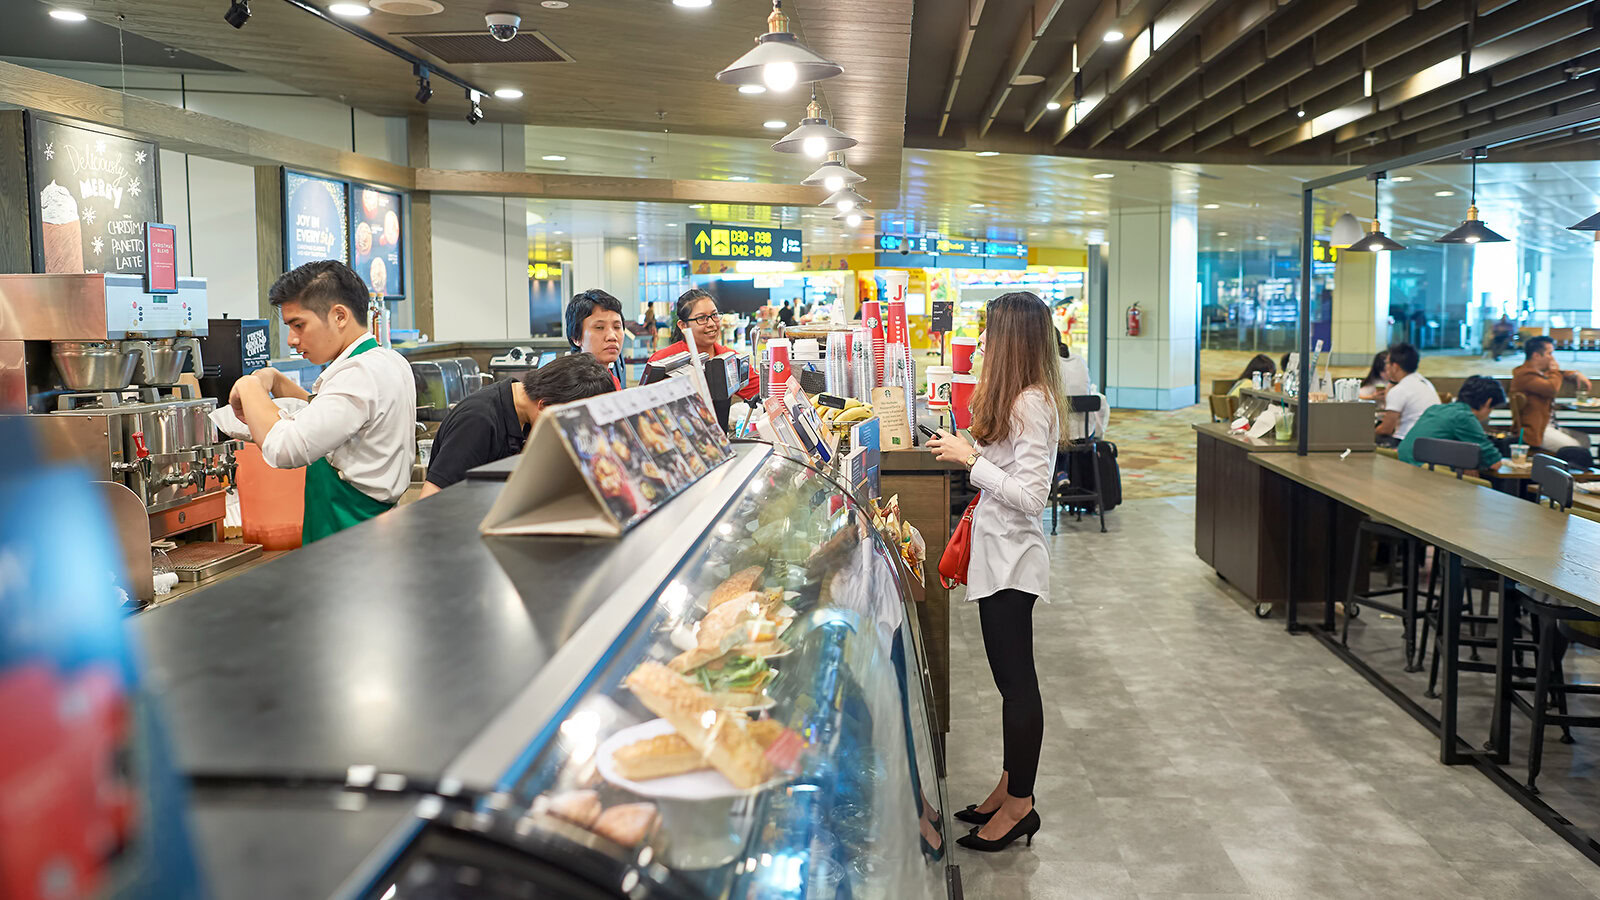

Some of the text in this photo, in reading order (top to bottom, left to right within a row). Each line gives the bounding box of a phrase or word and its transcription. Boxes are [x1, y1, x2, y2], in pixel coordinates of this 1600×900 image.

[79, 177, 123, 209] MERRY
[107, 220, 145, 235] CHRISTMA
[296, 214, 320, 229] JOY IN
[296, 229, 320, 244] EVERY
[731, 230, 748, 242] D30
[111, 239, 145, 255] PANETTO
[731, 244, 749, 256] D42
[115, 255, 143, 270] LATTE
[928, 383, 935, 400] J
